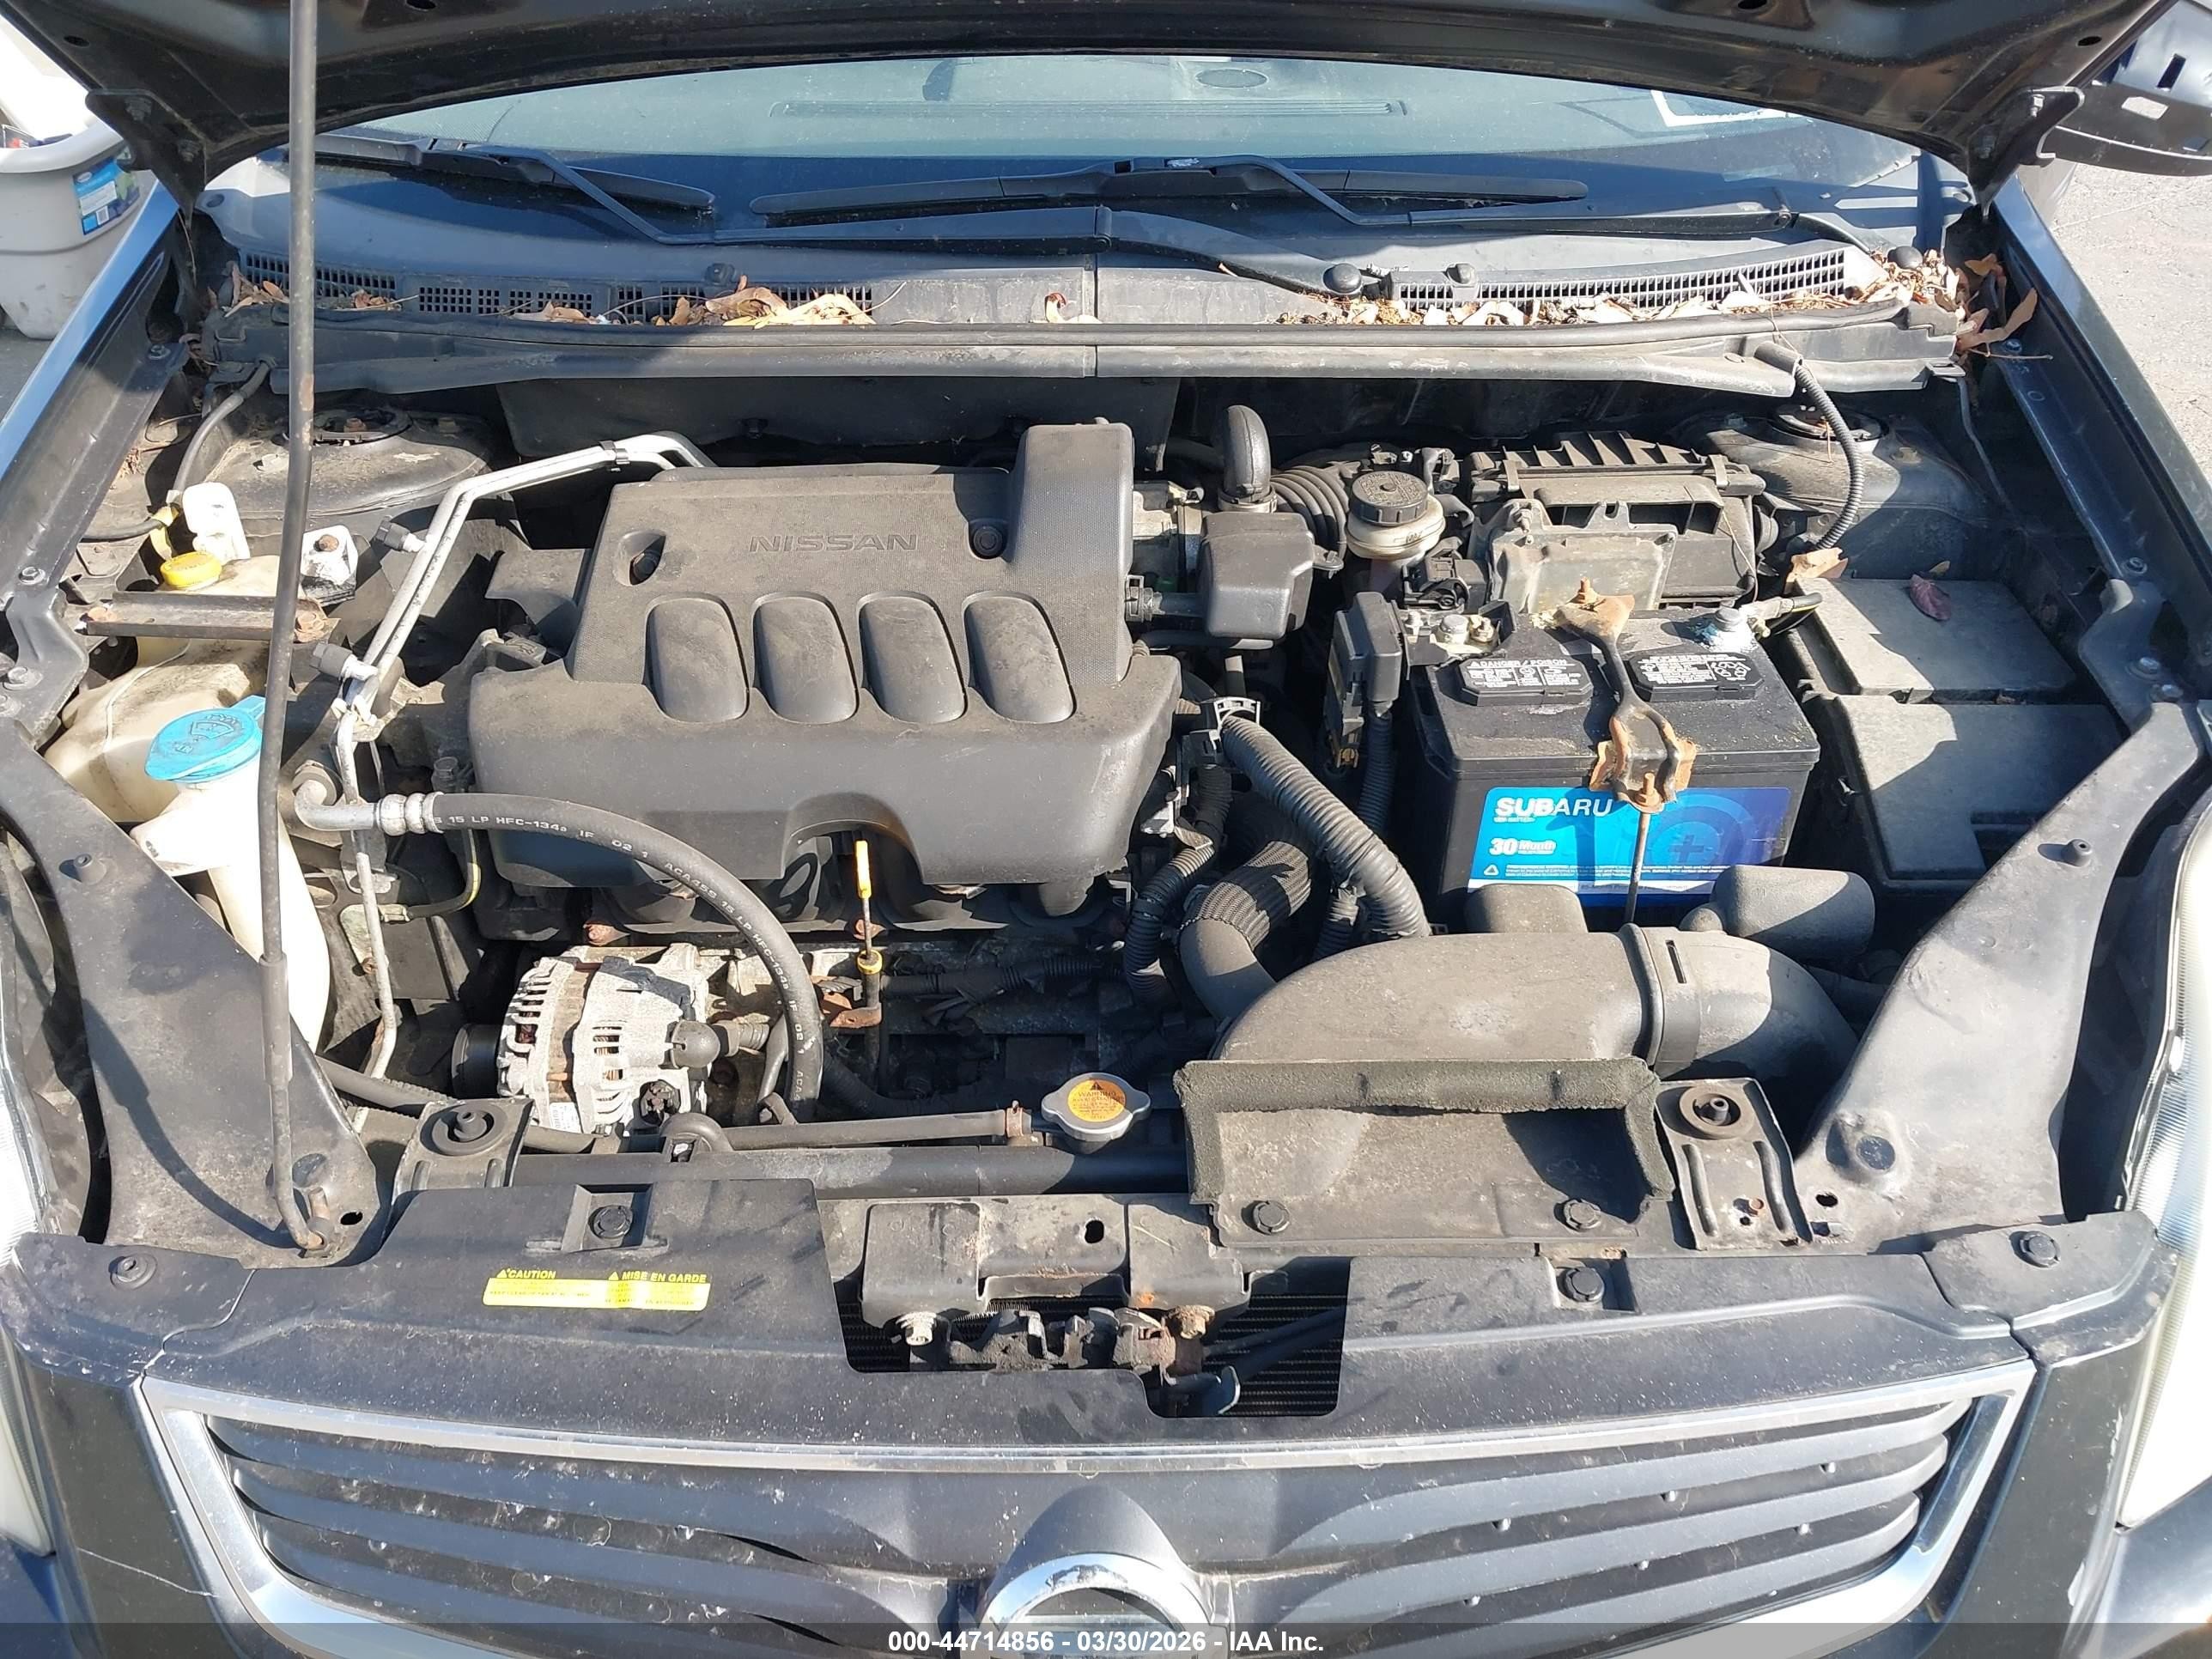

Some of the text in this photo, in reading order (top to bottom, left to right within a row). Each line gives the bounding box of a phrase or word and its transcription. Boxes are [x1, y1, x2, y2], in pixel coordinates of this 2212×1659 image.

[750, 534, 917, 552] NISSAN
[1494, 797, 1613, 816] SUBARU
[495, 817, 568, 832] HFC-134a
[1489, 837, 1518, 855] 30
[507, 1269, 556, 1279] CAUTION
[621, 1271, 707, 1284] MISE EN GARDE
